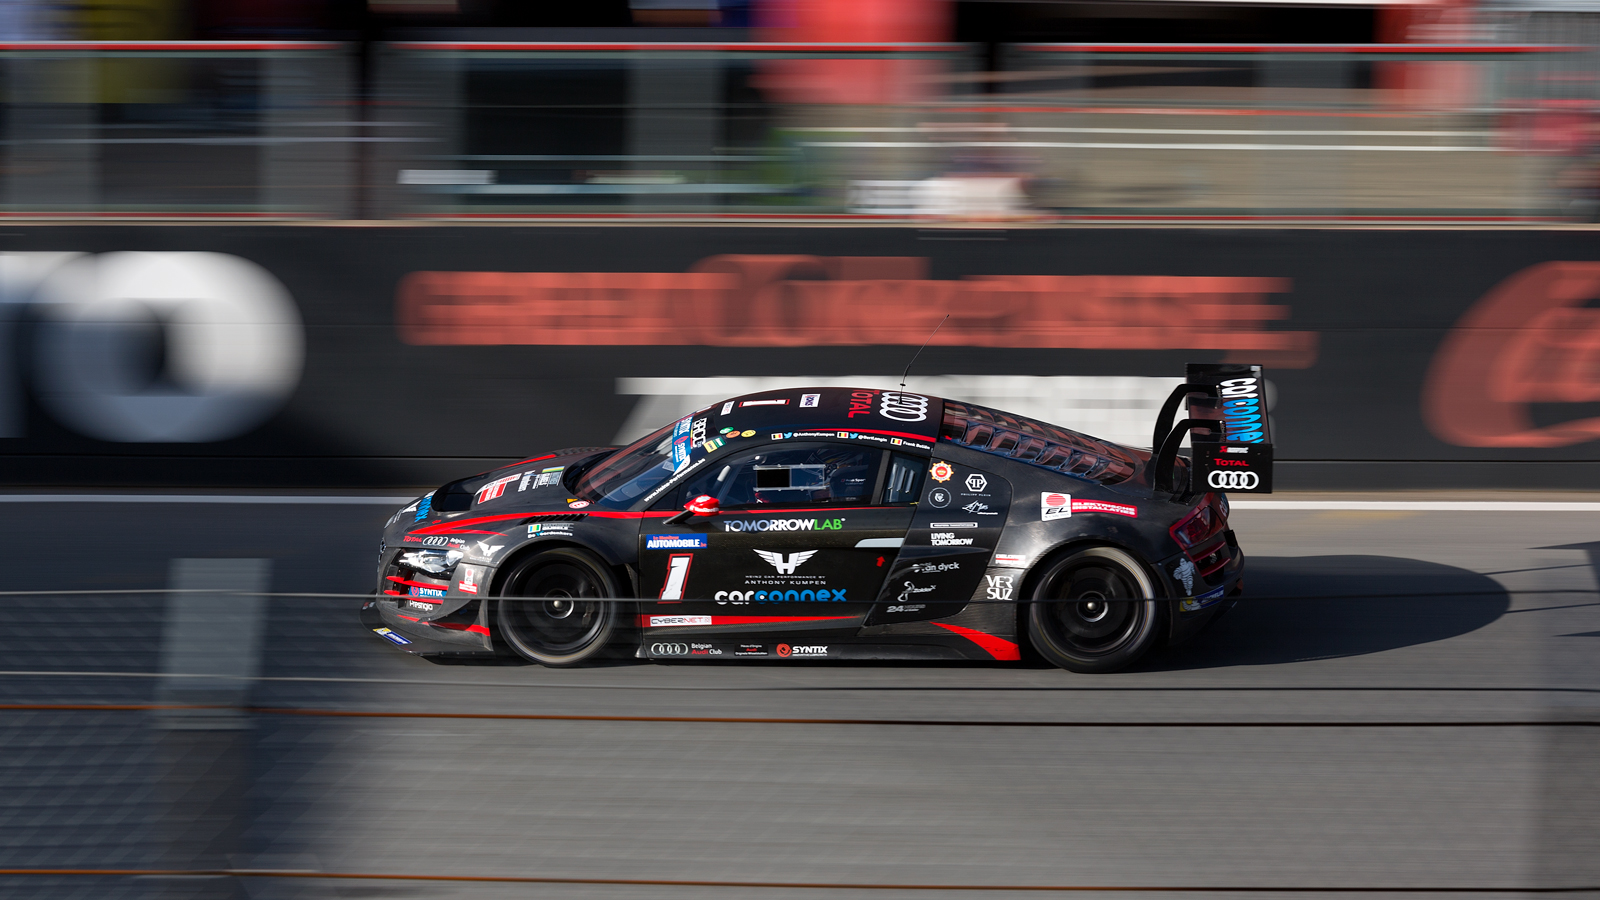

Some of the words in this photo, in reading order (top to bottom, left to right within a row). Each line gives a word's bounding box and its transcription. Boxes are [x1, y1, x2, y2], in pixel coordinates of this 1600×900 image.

[1220, 378, 1264, 443] carconne
[1214, 459, 1250, 467] TOTAL
[1072, 502, 1135, 512] ELEKTRISCHE
[930, 532, 955, 540] LIVING
[938, 562, 960, 572] dyck
[657, 553, 694, 604] 1
[419, 588, 443, 597] SYNTIX
[714, 588, 847, 605] carconnex
[651, 617, 704, 625] CYBERNET
